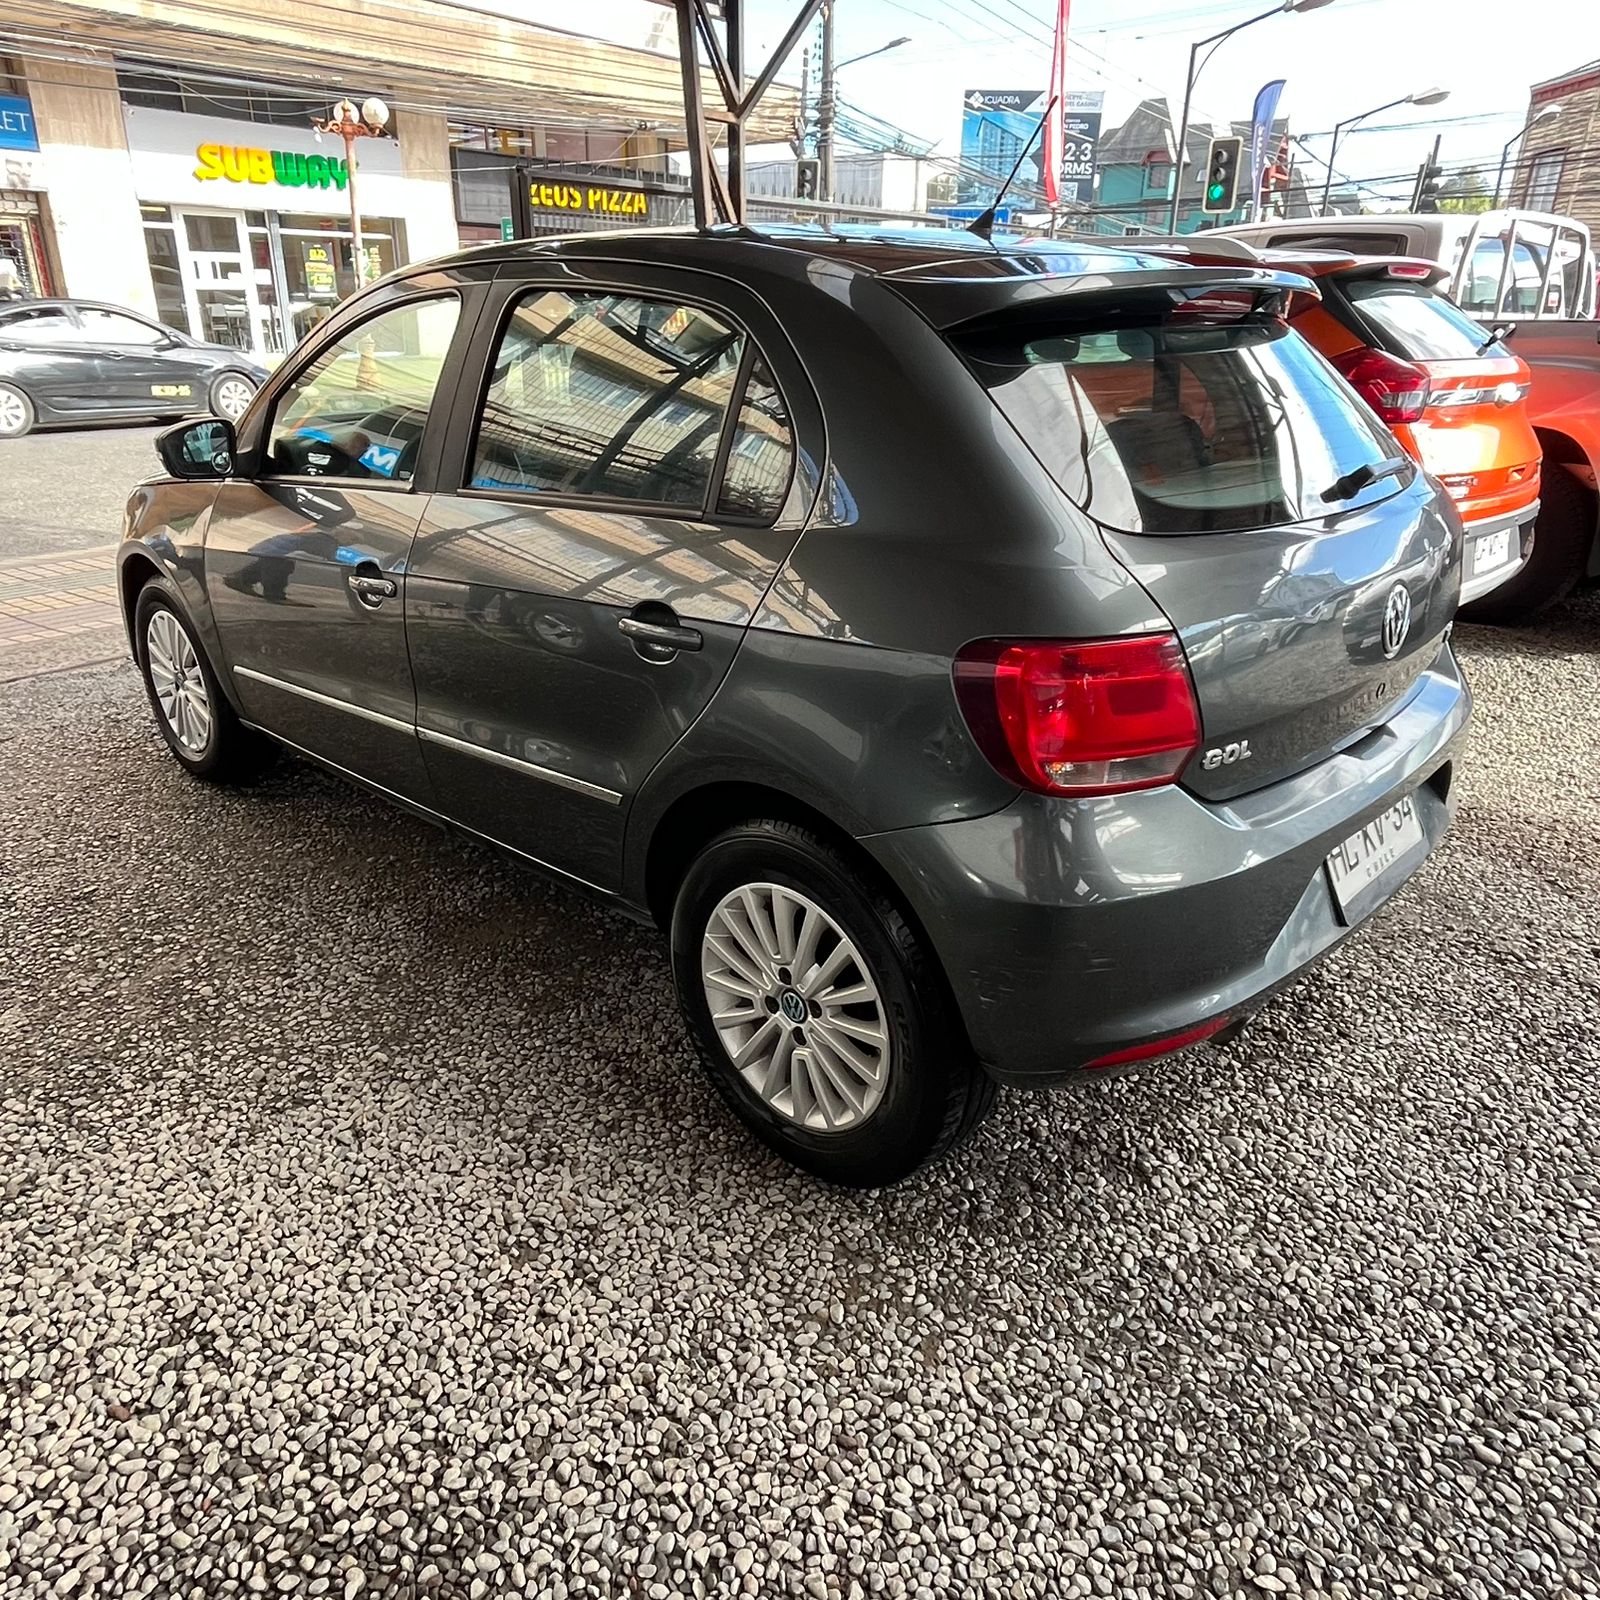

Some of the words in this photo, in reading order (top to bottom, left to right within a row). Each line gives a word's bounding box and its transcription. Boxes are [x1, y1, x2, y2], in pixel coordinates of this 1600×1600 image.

[193, 143, 358, 191] SUBWAY
[529, 183, 582, 209] ZEUS
[587, 187, 647, 214] PIZZA
[1202, 739, 1252, 770] GOL
[1366, 847, 1395, 878] CHILE
